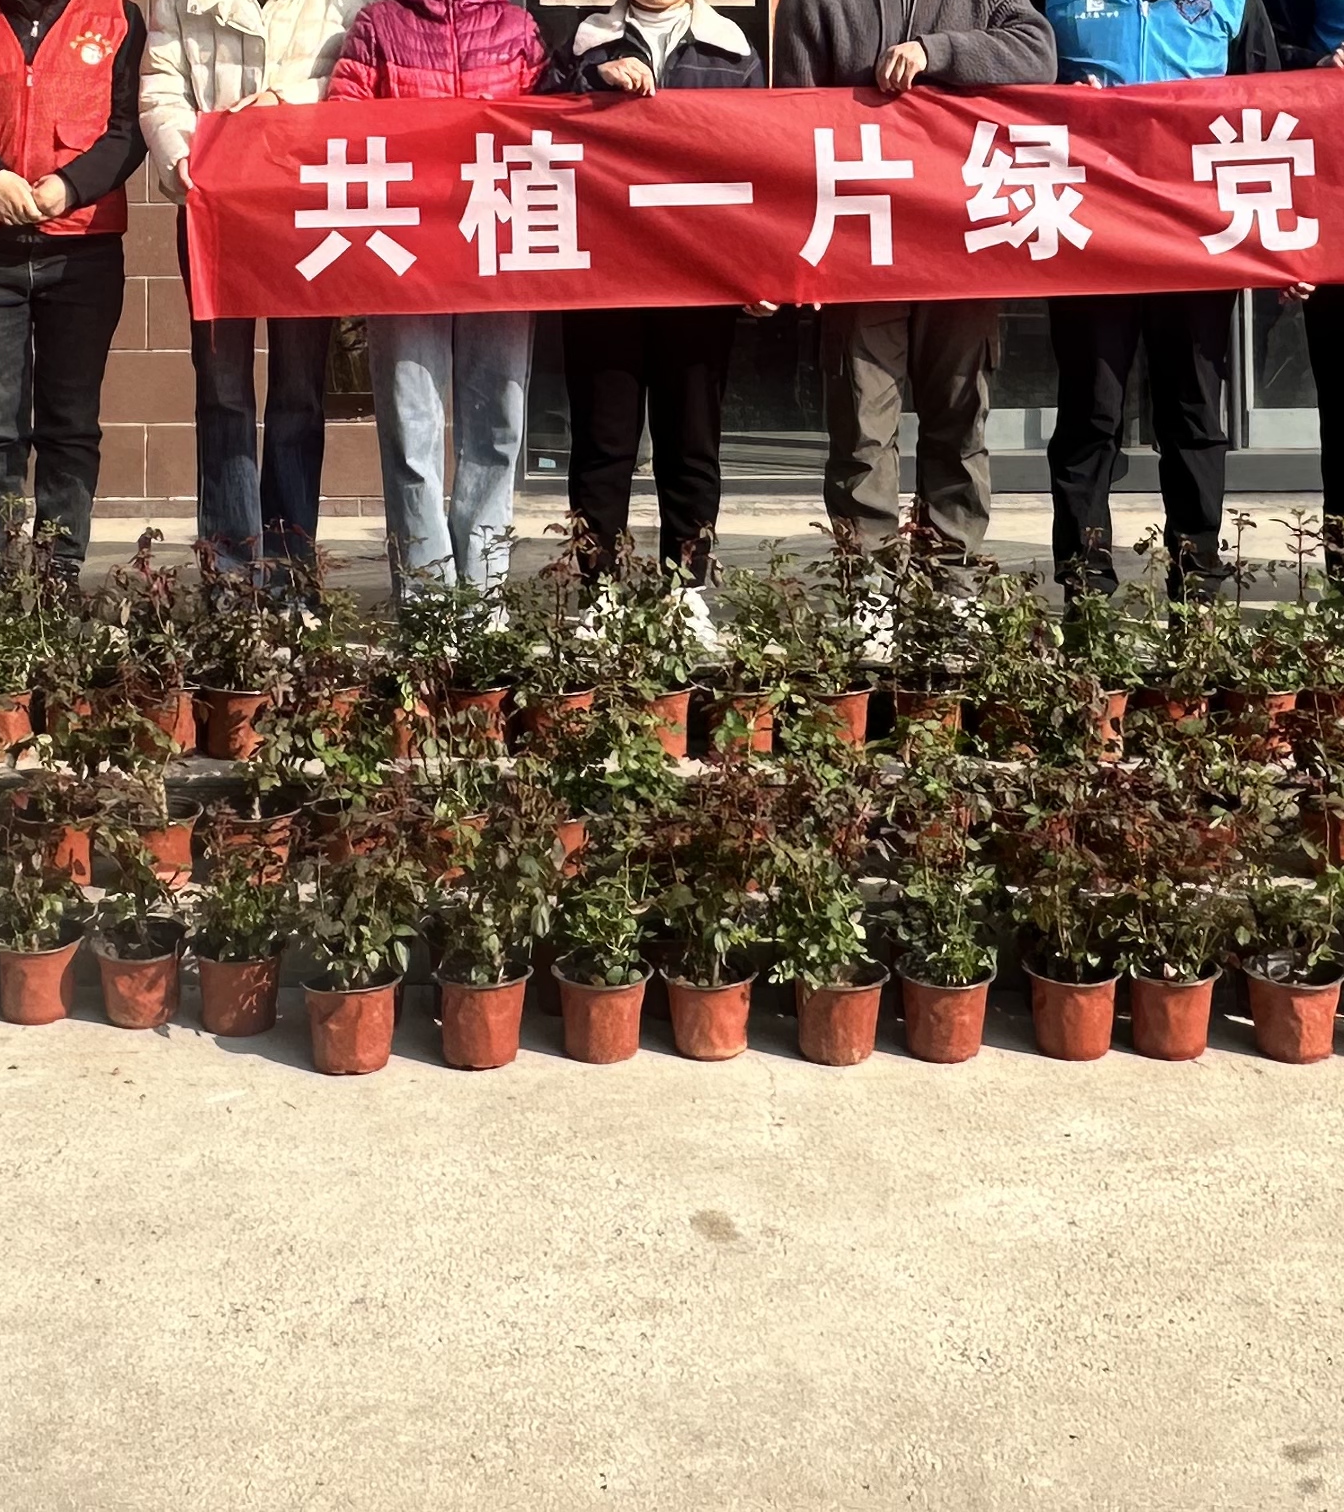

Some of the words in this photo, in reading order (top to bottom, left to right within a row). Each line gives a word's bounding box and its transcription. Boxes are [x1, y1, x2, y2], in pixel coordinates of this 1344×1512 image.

[294, 120, 1093, 281] 共植一片绿
